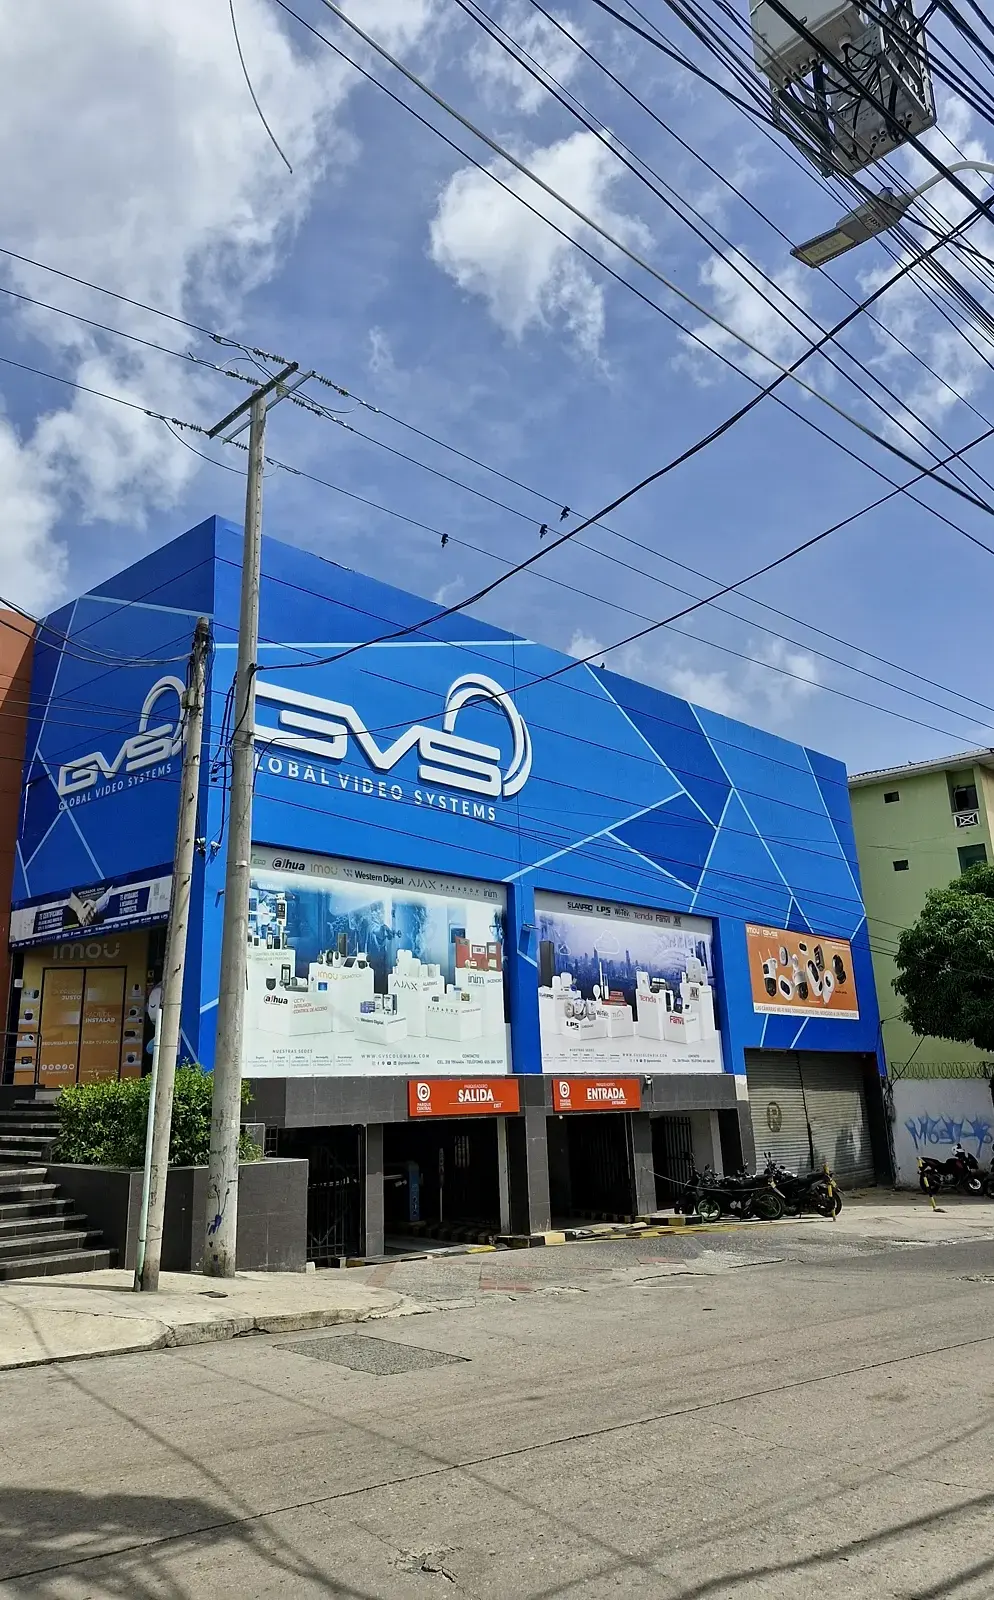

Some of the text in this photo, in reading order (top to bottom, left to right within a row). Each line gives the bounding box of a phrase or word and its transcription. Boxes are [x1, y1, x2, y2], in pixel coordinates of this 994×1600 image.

[254, 680, 501, 797] GVS
[58, 723, 174, 796] GVS
[58, 763, 172, 811] GLOBAL VIDEO SYSTEMS
[254, 752, 497, 822] LOBAL VIDEO SYSTEMS
[354, 870, 382, 883] Western
[383, 874, 404, 886] Digital
[408, 878, 436, 890] AJAX
[596, 906, 611, 914] LPS
[634, 912, 652, 921] Tenda
[394, 980, 418, 991] AJAX
[468, 974, 484, 984] inim
[639, 994, 656, 1003] Tenda
[458, 1088, 494, 1102] SALIDA
[587, 1088, 625, 1099] ENTRADA
